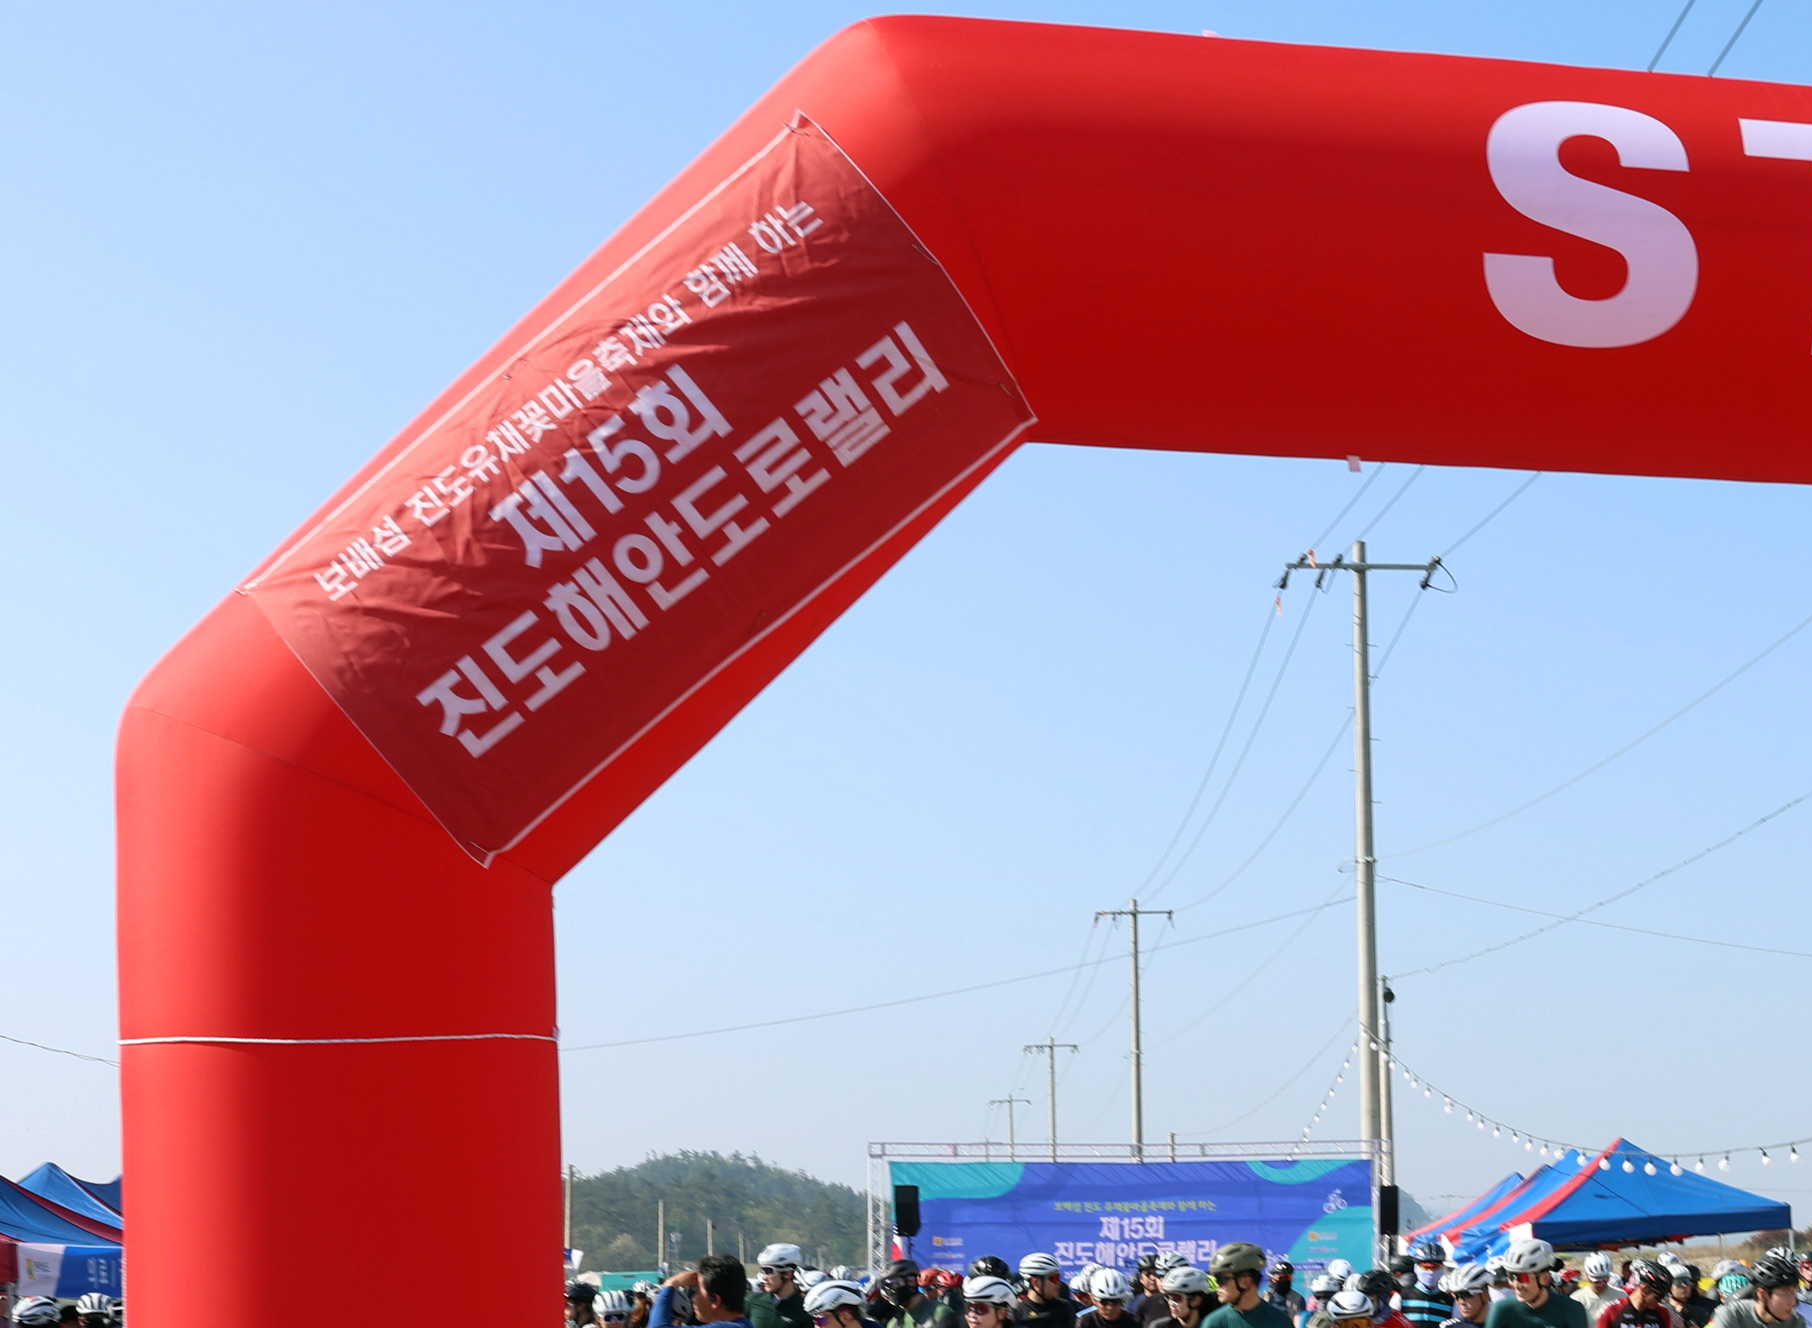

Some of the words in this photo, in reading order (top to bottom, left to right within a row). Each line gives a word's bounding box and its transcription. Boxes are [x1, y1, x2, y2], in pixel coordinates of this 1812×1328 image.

[313, 523, 412, 602] 보배섬
[403, 297, 691, 530] 진도유채꽃마을축제와
[683, 242, 759, 306] 함께
[748, 201, 824, 258] 하는
[415, 321, 951, 760] 진도해안도로랠리
[489, 364, 734, 569] 제15회
[1099, 1215, 1165, 1241] 제15회
